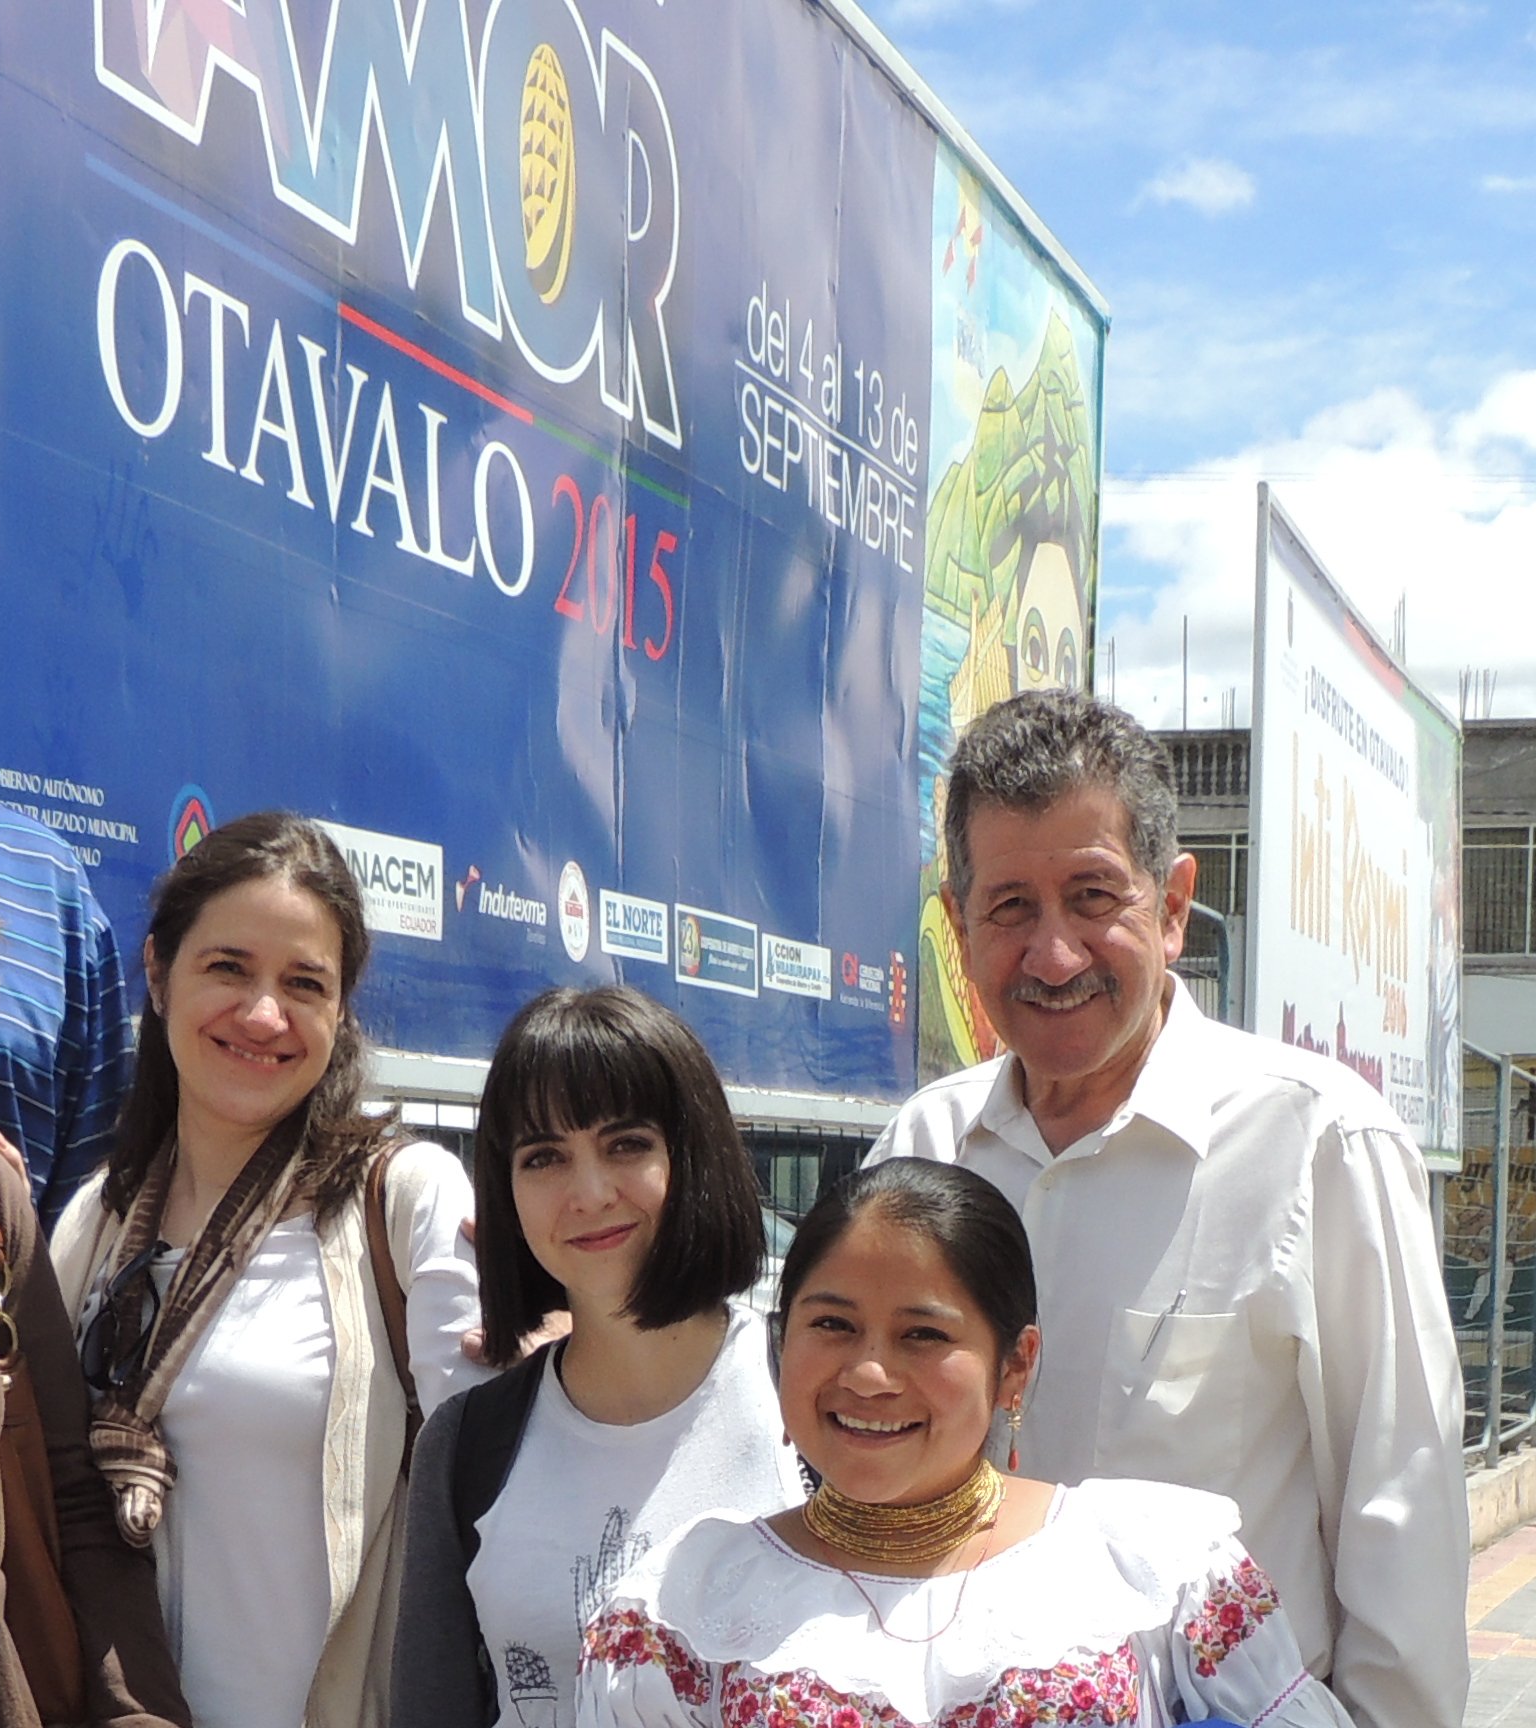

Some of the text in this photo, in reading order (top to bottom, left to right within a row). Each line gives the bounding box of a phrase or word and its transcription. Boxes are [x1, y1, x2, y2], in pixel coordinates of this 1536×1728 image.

[94, 0, 682, 449] AMOR
[747, 279, 918, 476] del 4 al 13 de
[97, 239, 679, 661] OTAVALO 2015
[739, 382, 915, 574] SEPTIEMBRE
[42, 777, 105, 808] AUTÓNOMO
[87, 816, 140, 844] MUNICIPAL
[478, 881, 548, 926] Indutexma
[605, 900, 620, 929] EL
[622, 903, 663, 938] NORTE
